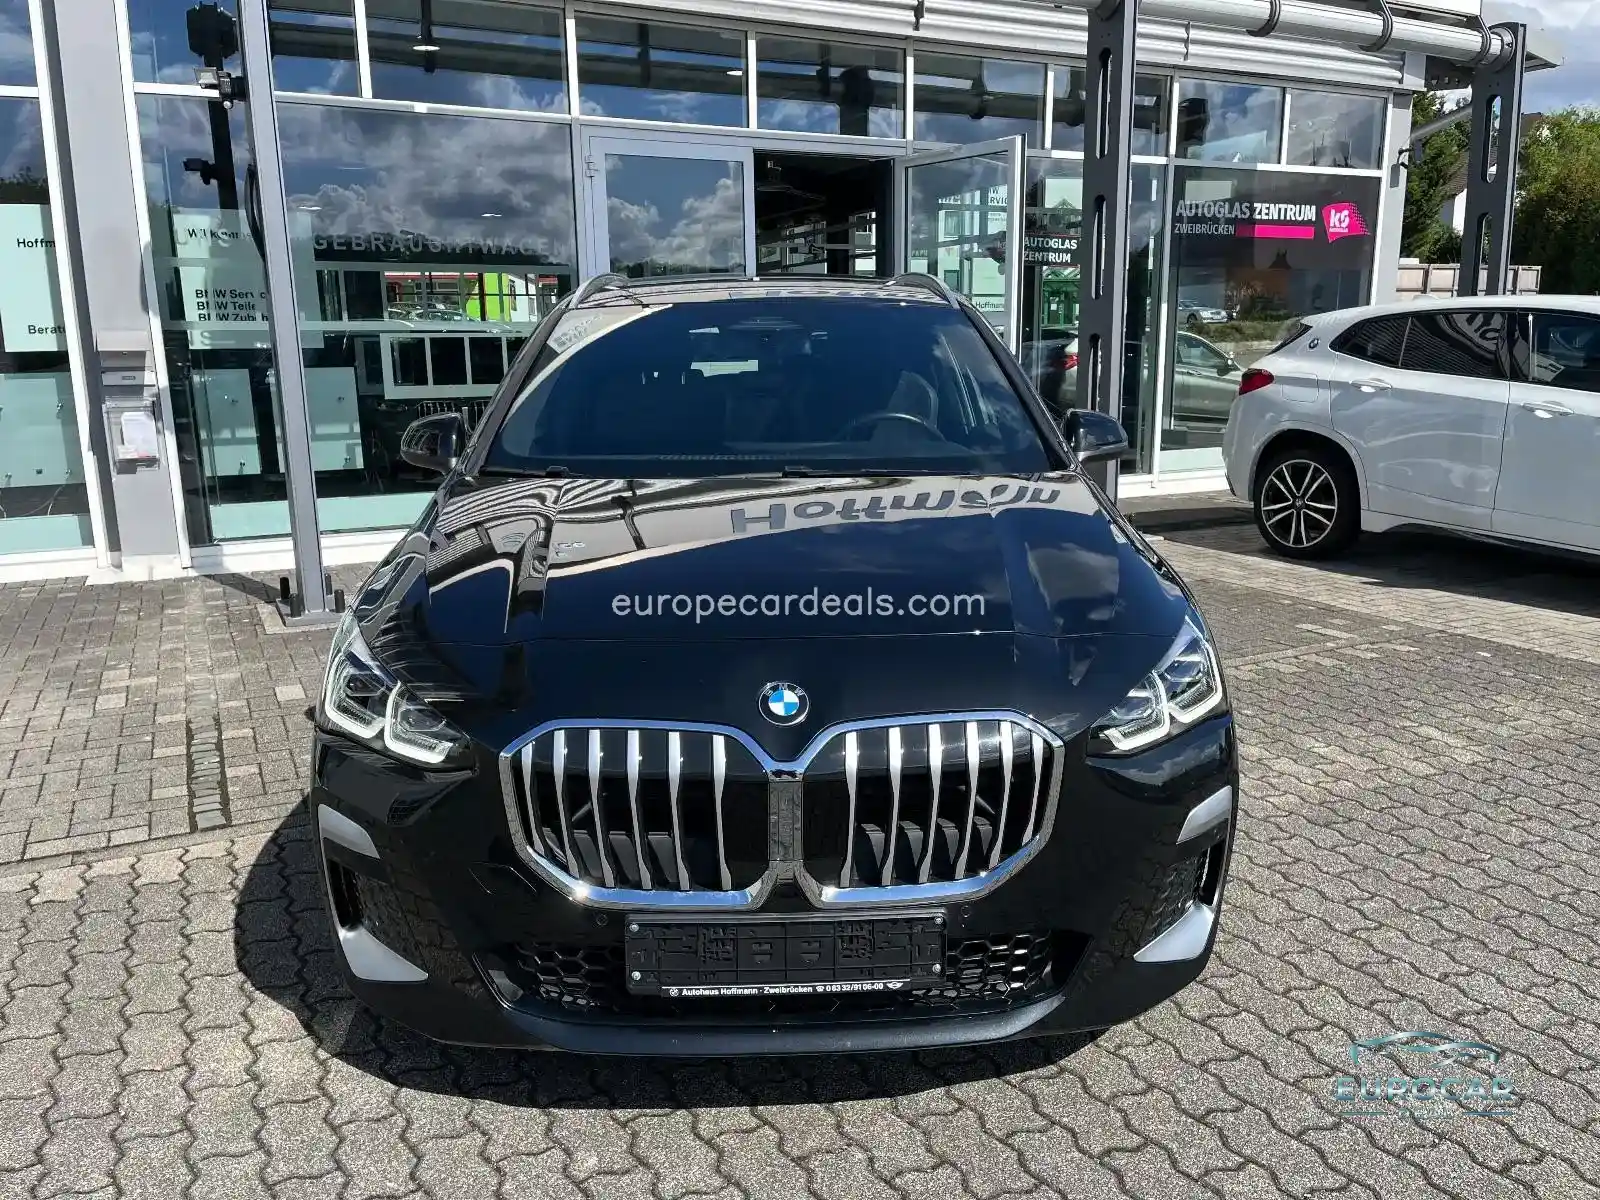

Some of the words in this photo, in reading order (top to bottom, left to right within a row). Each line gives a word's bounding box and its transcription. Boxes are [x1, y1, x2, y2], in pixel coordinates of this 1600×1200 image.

[1175, 199, 1251, 219] AUTOGLAS
[1253, 202, 1317, 222] ZENTRUM
[1174, 223, 1236, 236] ZWEIBRÜCKEN
[1024, 236, 1078, 250] AUTOGLAS
[1024, 250, 1072, 263] ZENTRUM
[682, 988, 719, 996] Autohaus
[720, 987, 758, 995] Hoffmann
[763, 985, 813, 994] Zweibrücken
